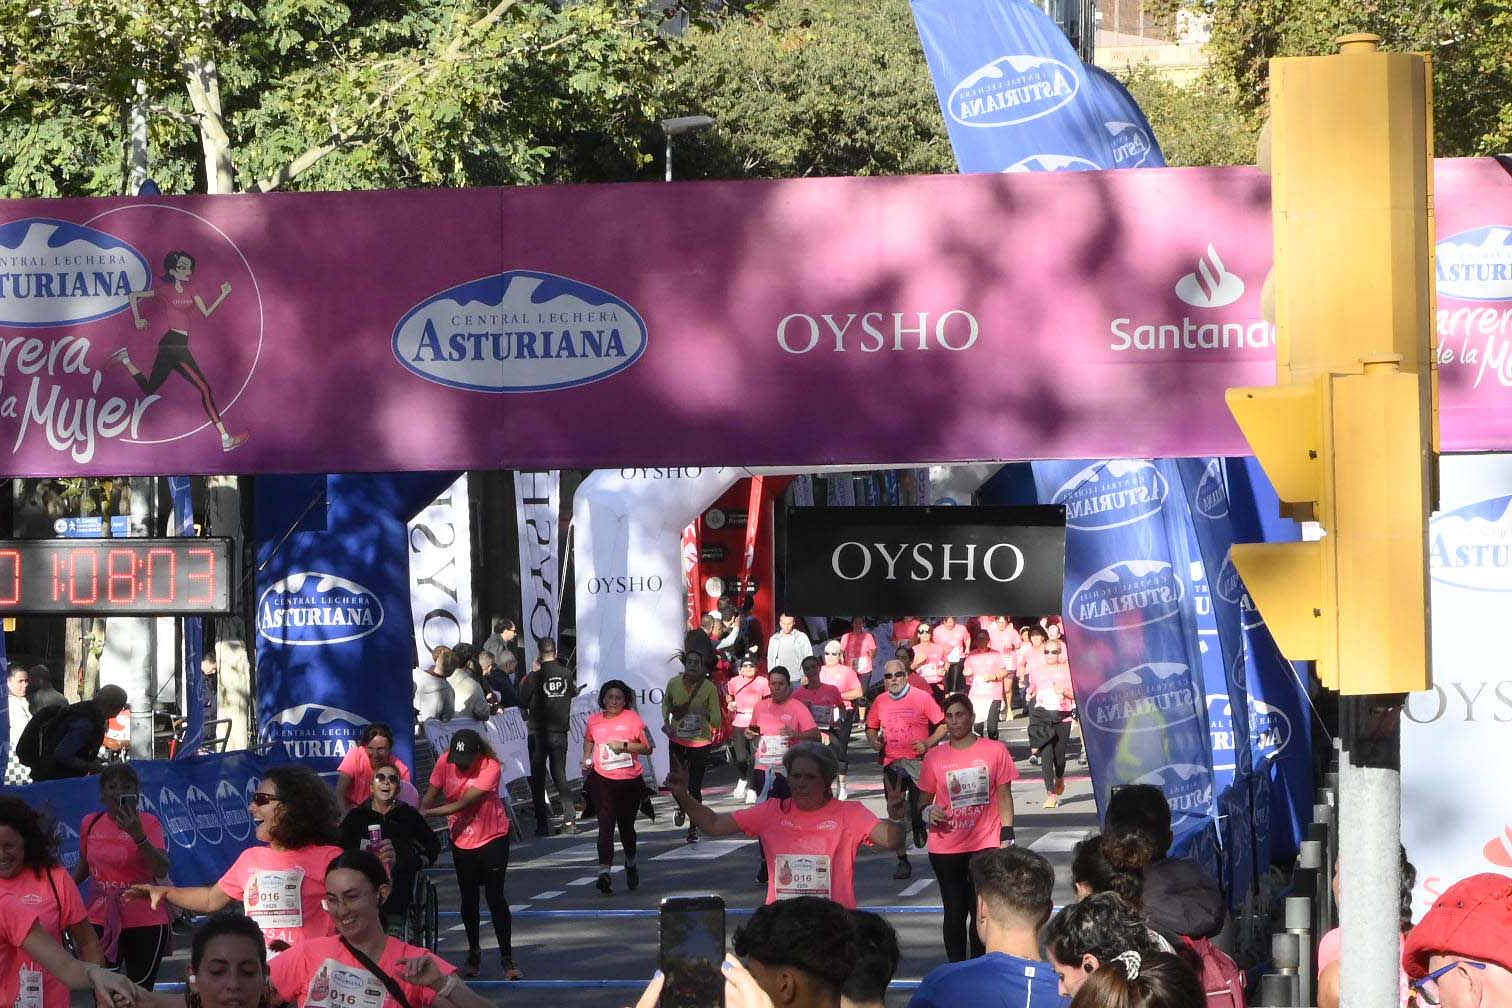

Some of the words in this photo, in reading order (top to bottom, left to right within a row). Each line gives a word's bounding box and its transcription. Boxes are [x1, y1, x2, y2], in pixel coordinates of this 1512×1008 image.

[54, 255, 127, 267] LECHERA
[450, 312, 530, 326] CENTRAL
[537, 311, 619, 324] LECHERA
[412, 317, 627, 362] ASTURIANA
[776, 309, 979, 354] OYSHO
[1460, 337, 1479, 364] la
[13, 369, 162, 463] Mujer
[832, 541, 1025, 583] OYSHO
[586, 575, 663, 595] OYSHO
[274, 596, 318, 606] CENTRAL
[320, 596, 370, 605] LECHERA
[262, 601, 374, 630] ASTURIANA
[549, 681, 562, 691] BP
[261, 893, 280, 901] 016
[330, 989, 356, 1005] 016
